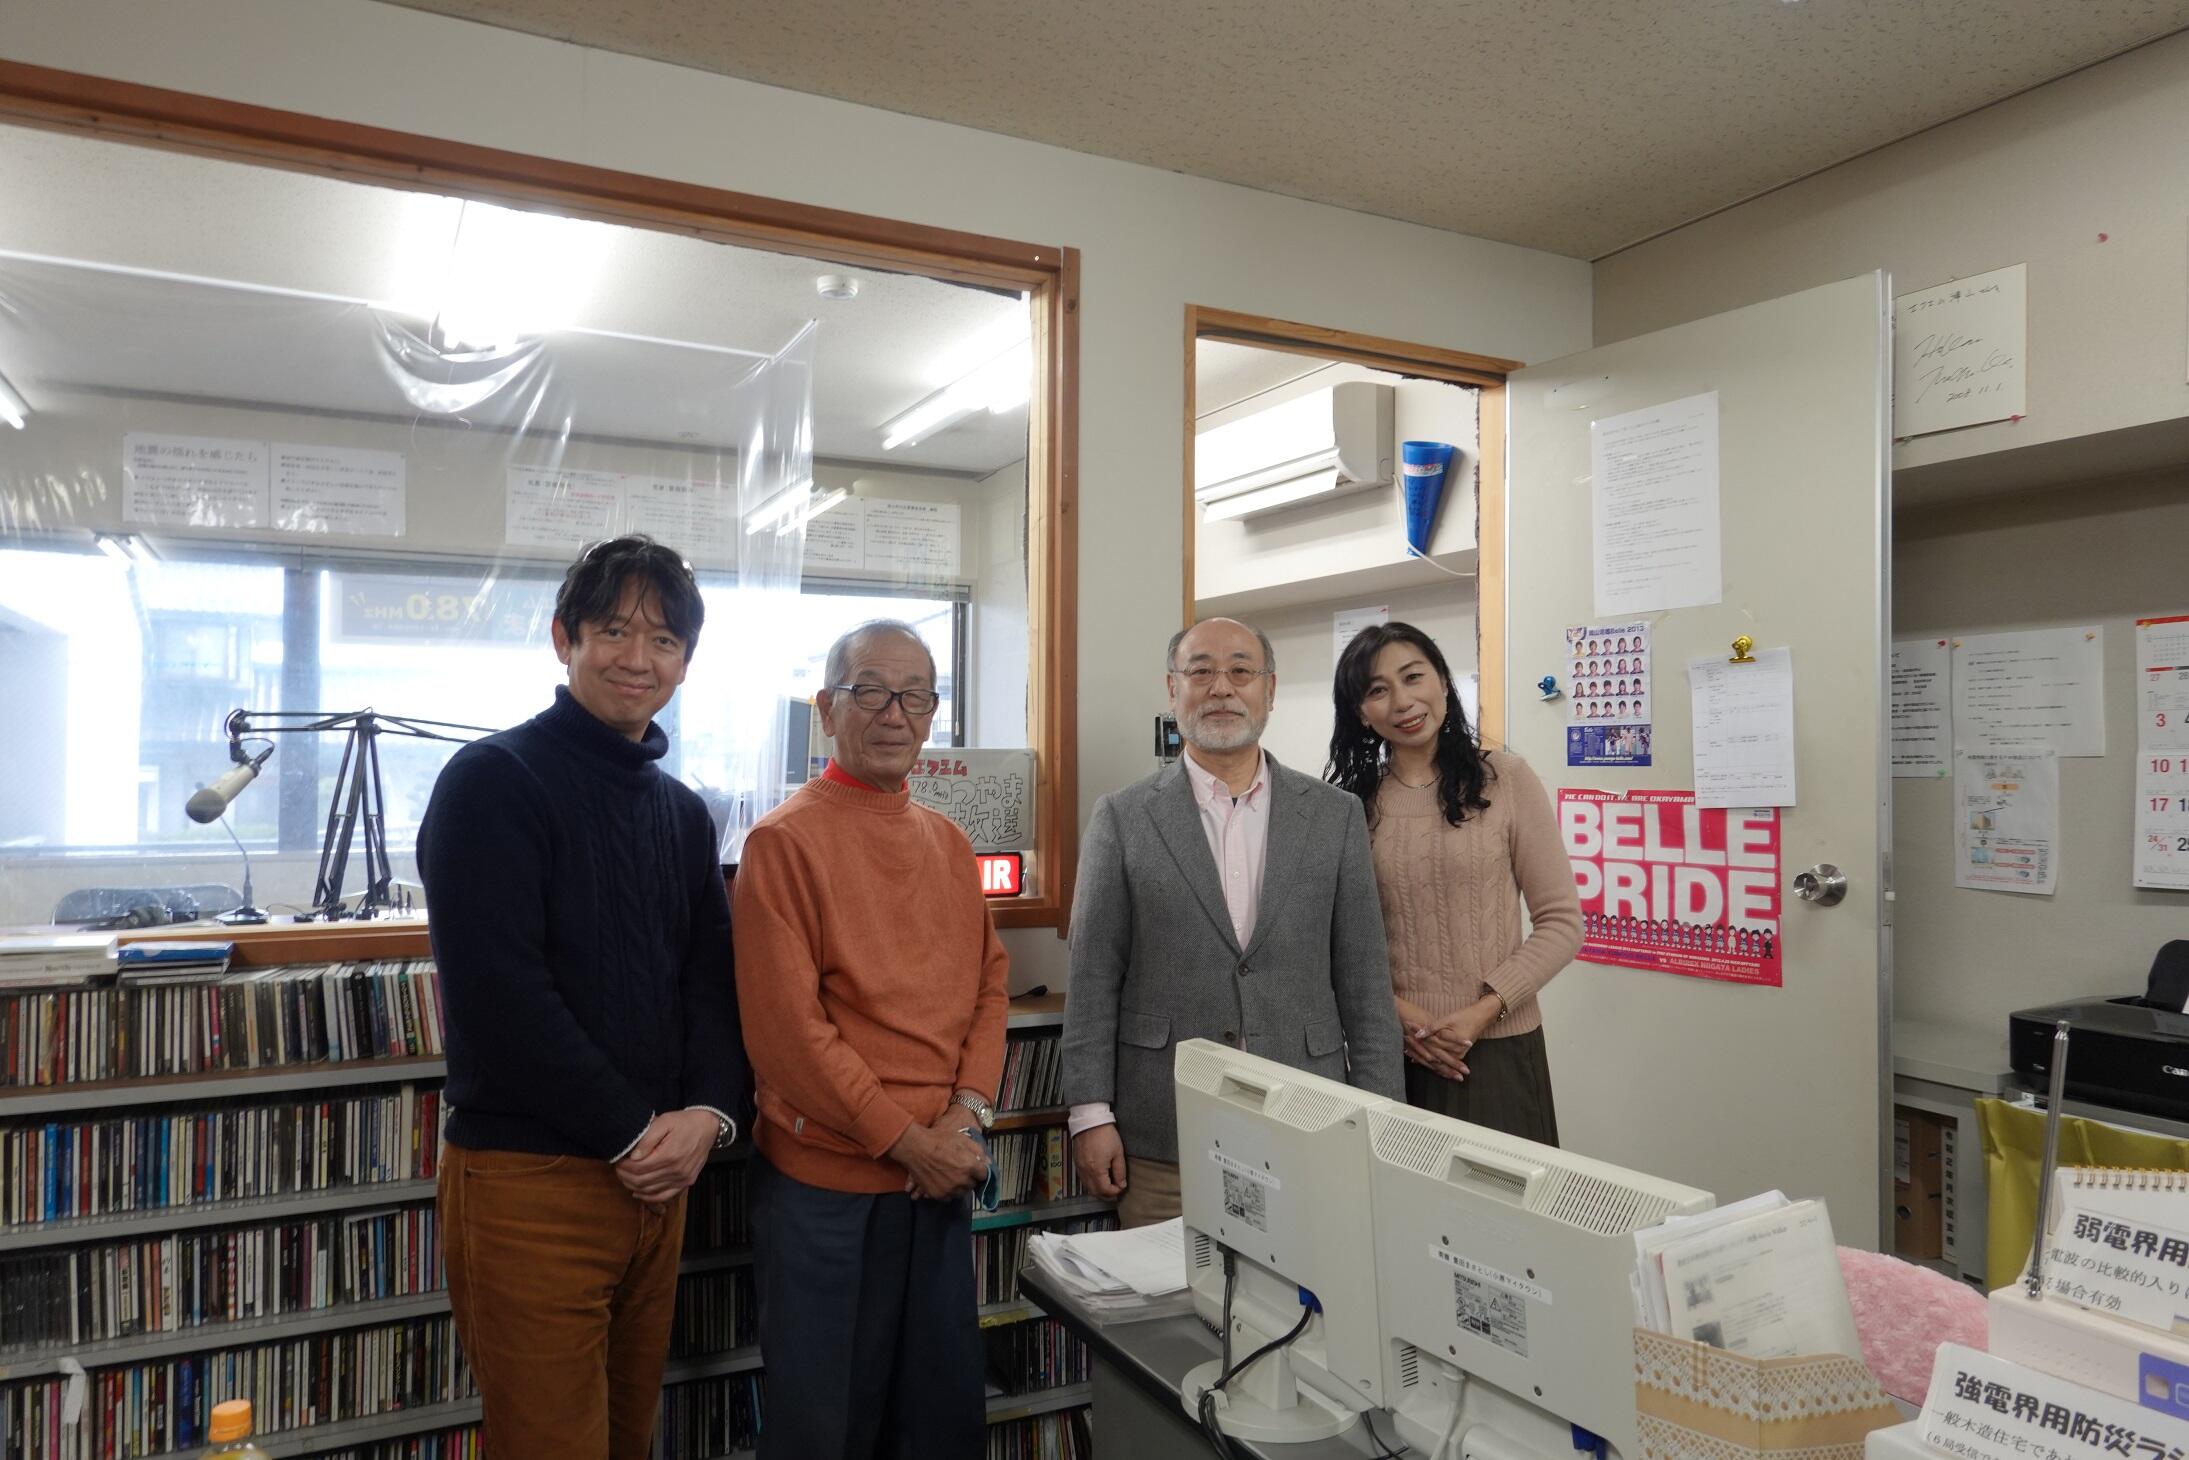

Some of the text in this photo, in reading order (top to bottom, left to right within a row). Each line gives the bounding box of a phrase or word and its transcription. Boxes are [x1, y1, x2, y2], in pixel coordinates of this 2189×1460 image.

[2155, 713, 2166, 728] 3
[2151, 758, 2169, 773] 10
[2149, 797, 2169, 811] 17
[1561, 801, 1777, 869] BELLE
[983, 859, 1013, 890] IR
[1569, 859, 1777, 935] PRIDE
[1669, 958, 1699, 968] ALBIREX
[1732, 965, 1760, 975] LADIES
